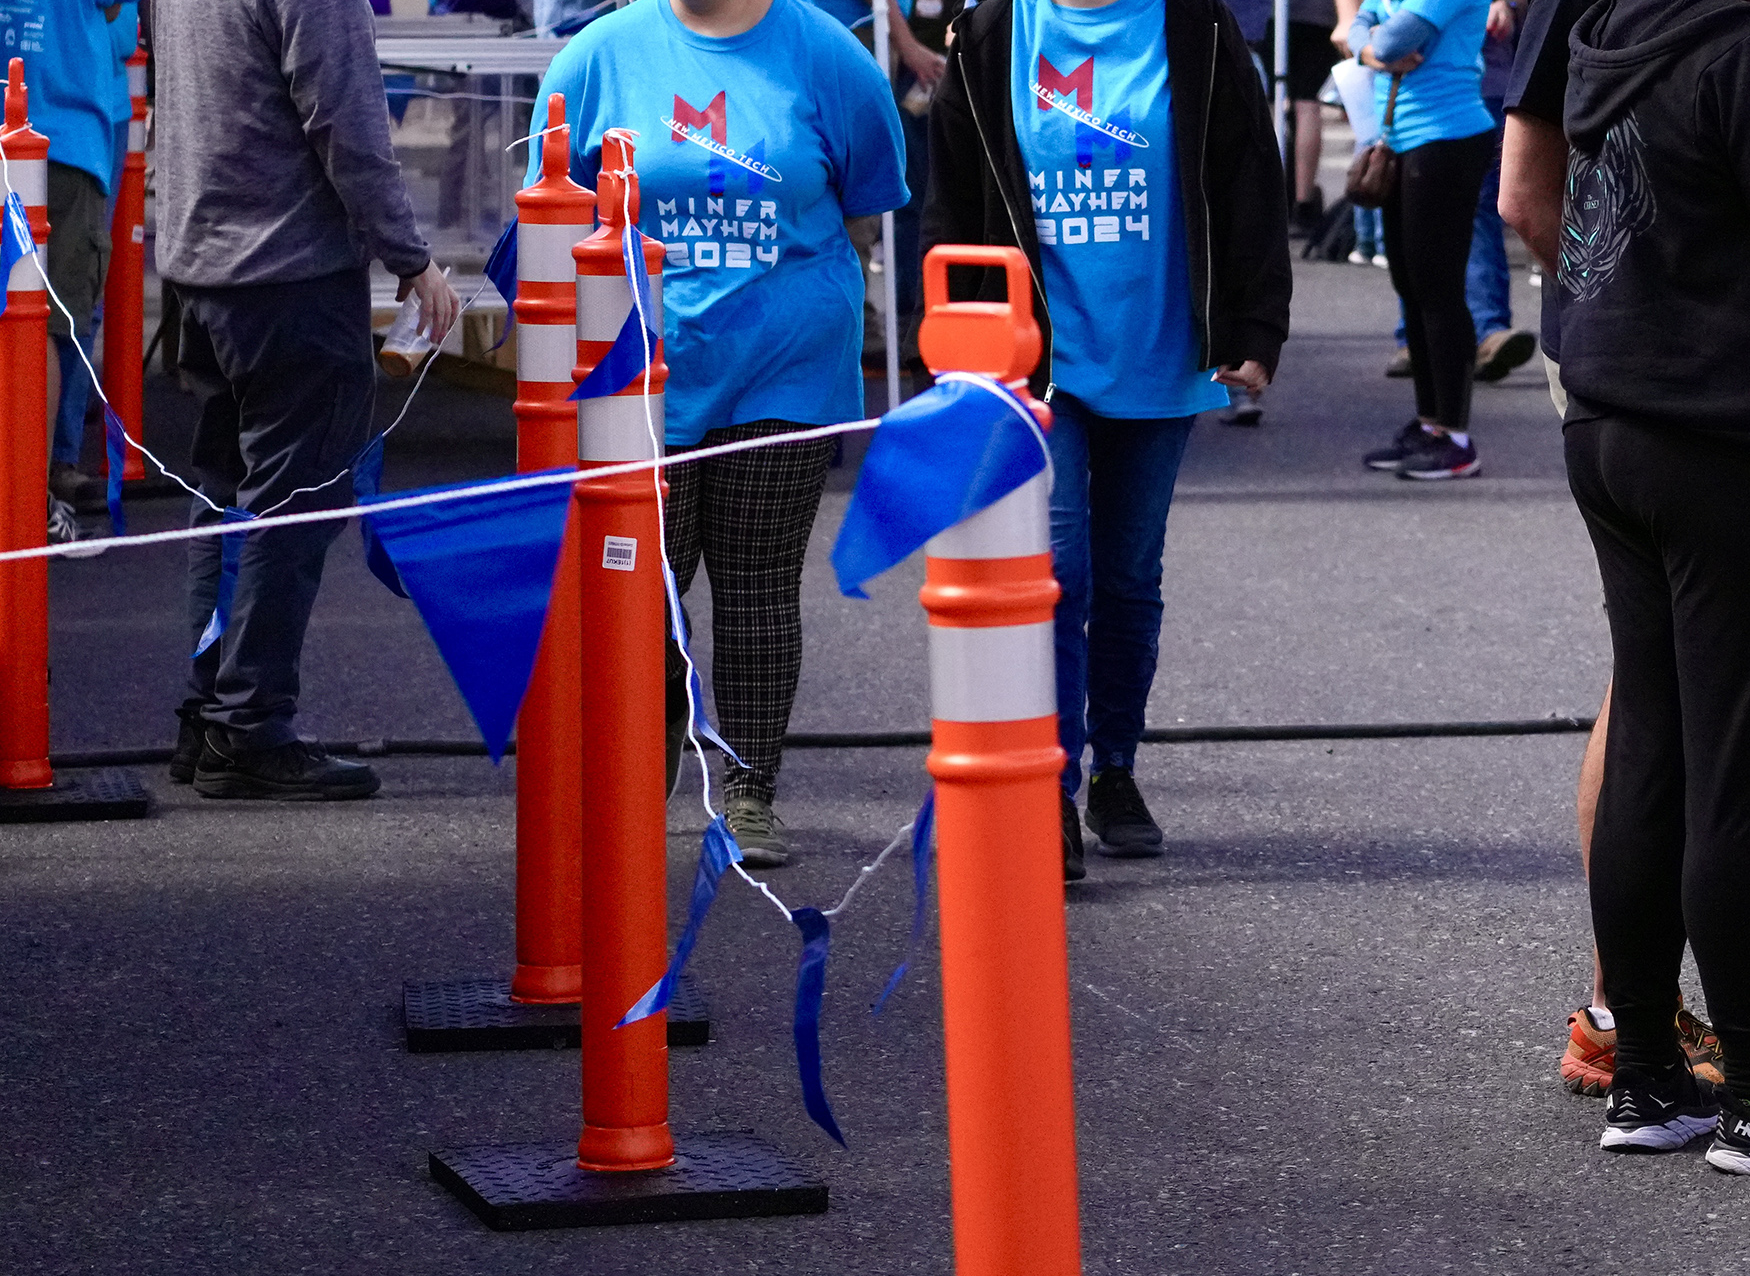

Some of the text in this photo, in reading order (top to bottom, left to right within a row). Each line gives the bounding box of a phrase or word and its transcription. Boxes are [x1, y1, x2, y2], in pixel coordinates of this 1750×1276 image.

[1032, 82, 1137, 142] NEW MEXICO TECH
[667, 118, 771, 175] NEW MEXICO TECH
[1028, 168, 1147, 191] MINER
[656, 196, 777, 220] MINER
[1031, 190, 1148, 214] MAYHEM
[660, 216, 778, 241] MAYHEM
[1034, 214, 1150, 246] 2024
[664, 241, 779, 269] 2024
